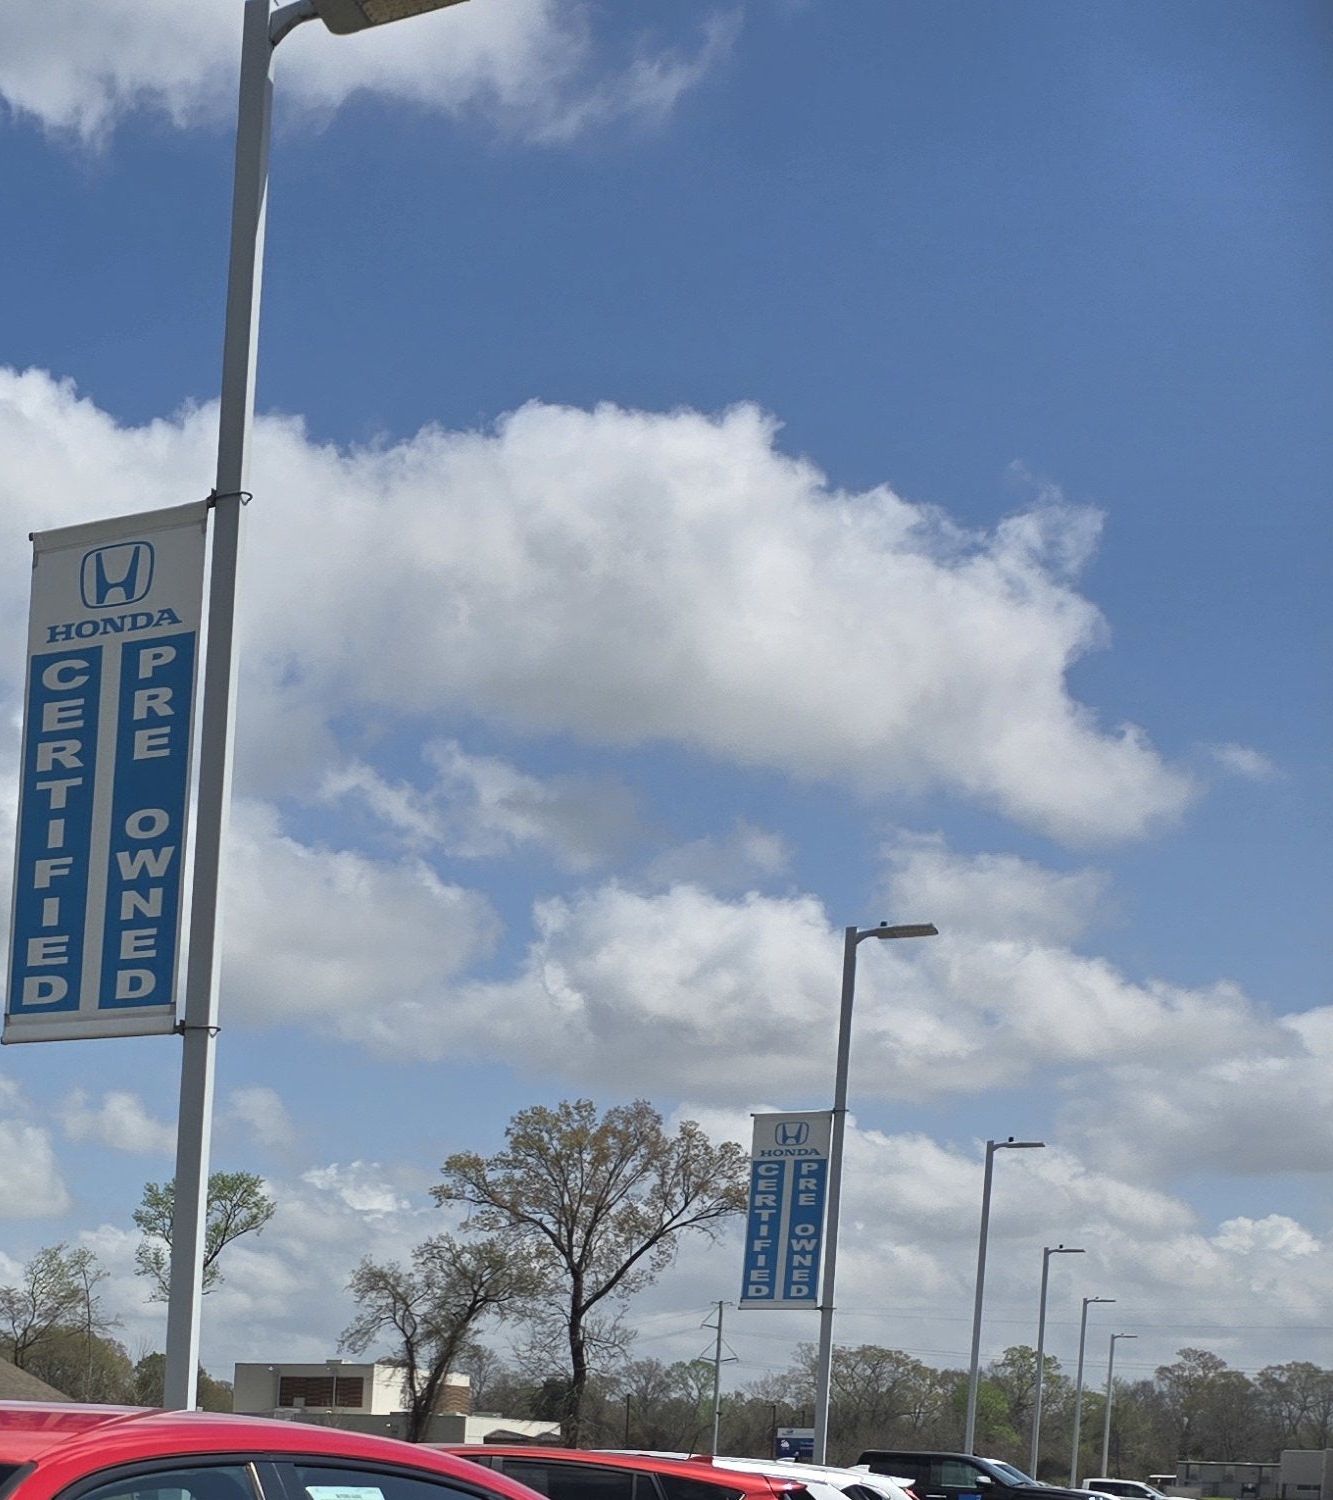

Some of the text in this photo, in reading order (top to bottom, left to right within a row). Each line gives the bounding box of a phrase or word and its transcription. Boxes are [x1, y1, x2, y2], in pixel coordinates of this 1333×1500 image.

[46, 607, 182, 644] HONDA
[21, 659, 90, 1006] CERTIFIED
[114, 645, 177, 1000] PRE OWNED
[760, 1148, 821, 1158] HONDA
[747, 1163, 780, 1297] CERTIFIED
[790, 1162, 819, 1297] PRE OWNED
